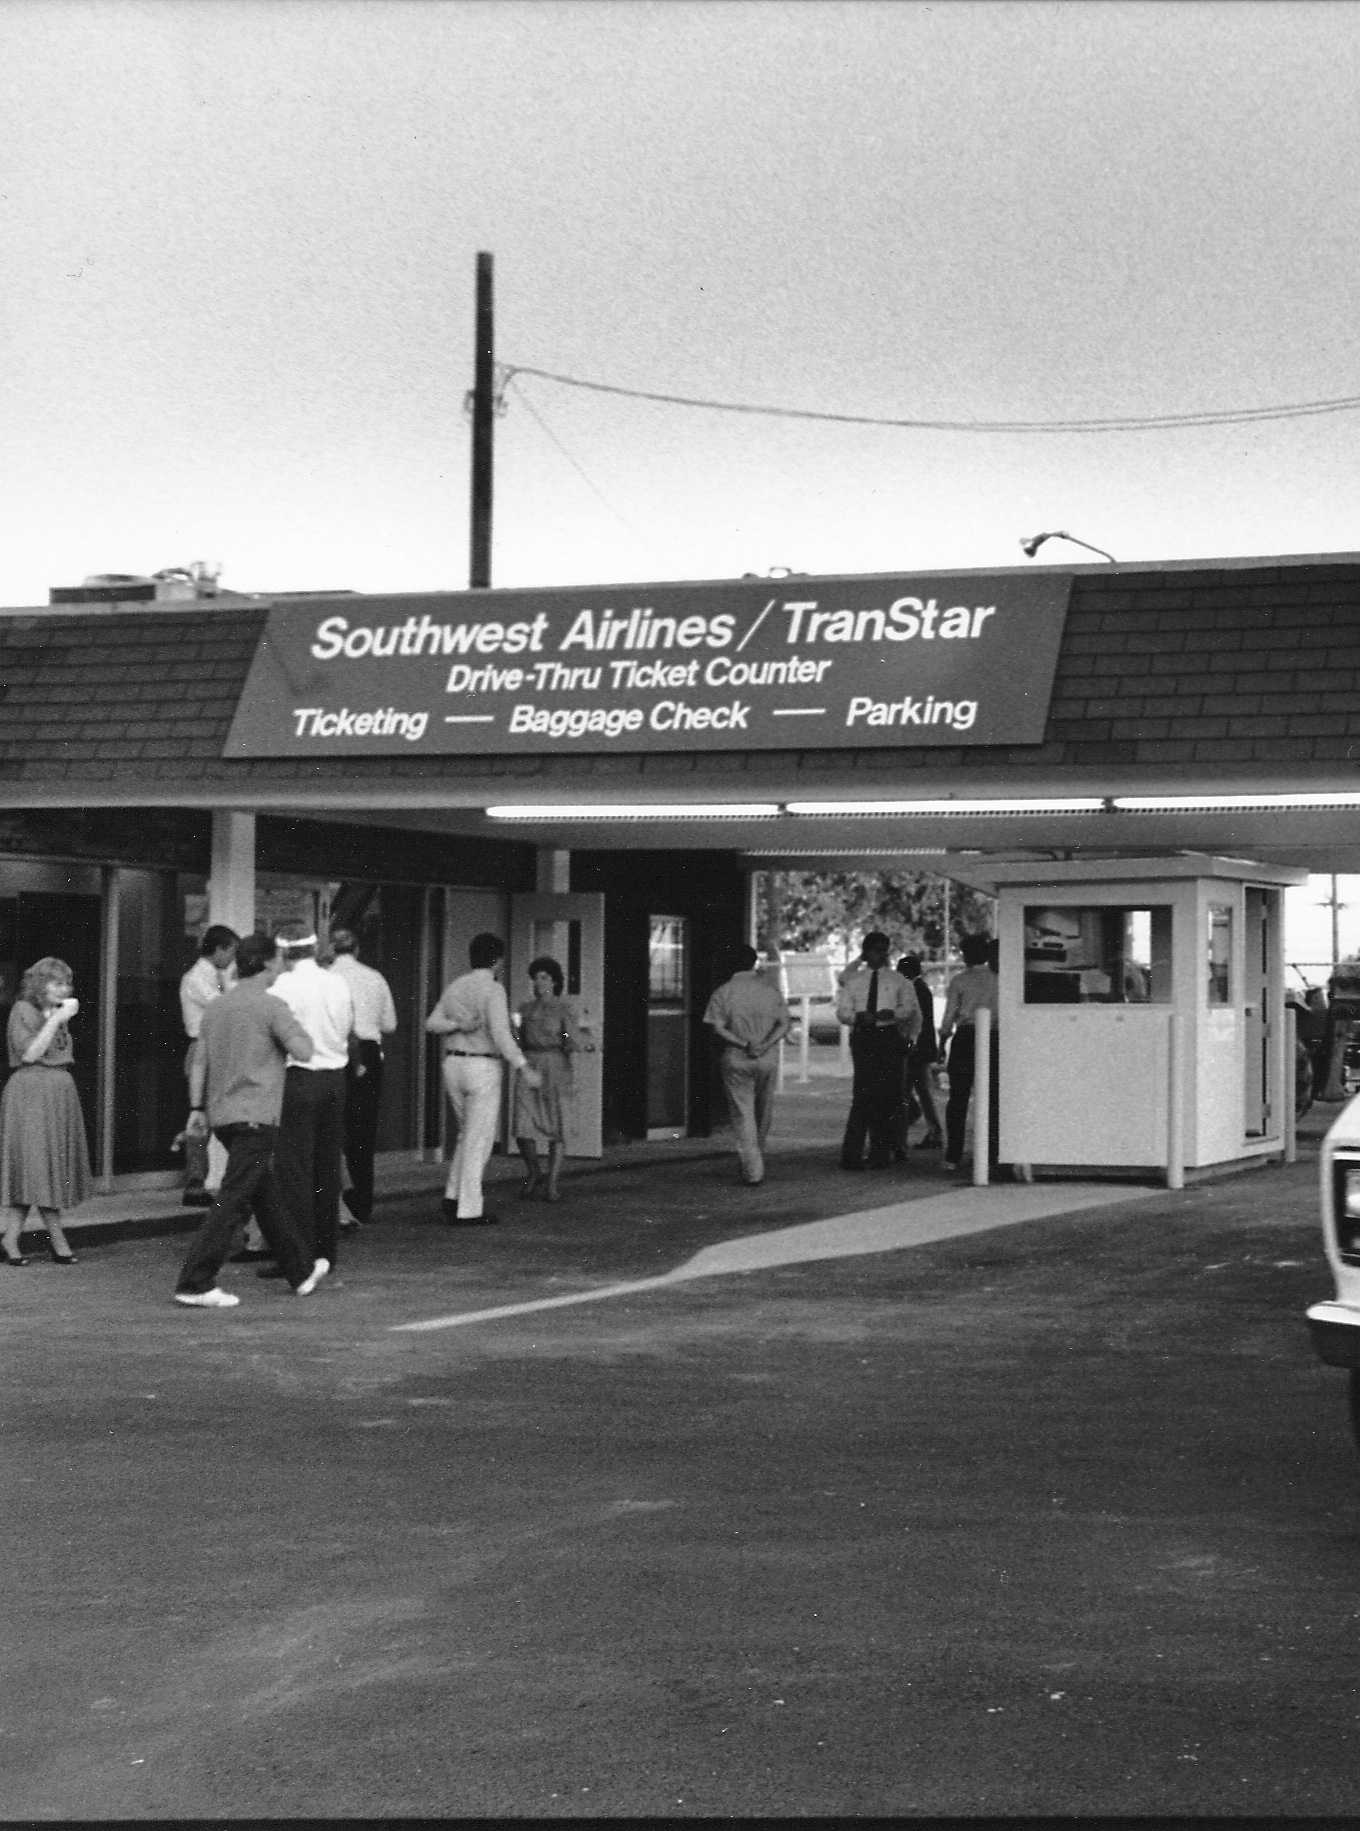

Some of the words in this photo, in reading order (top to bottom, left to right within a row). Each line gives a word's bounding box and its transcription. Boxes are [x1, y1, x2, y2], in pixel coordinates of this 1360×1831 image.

[310, 612, 549, 660] Southwest
[558, 607, 735, 651] Airlines
[782, 596, 997, 644] TranStar
[445, 661, 603, 693] Drive-Thru
[609, 659, 701, 689] Ticket
[704, 655, 833, 687] Counter
[293, 706, 429, 741] Ticketing
[508, 704, 645, 738] Baggage
[649, 700, 751, 731] Check
[845, 695, 979, 731] Parking
